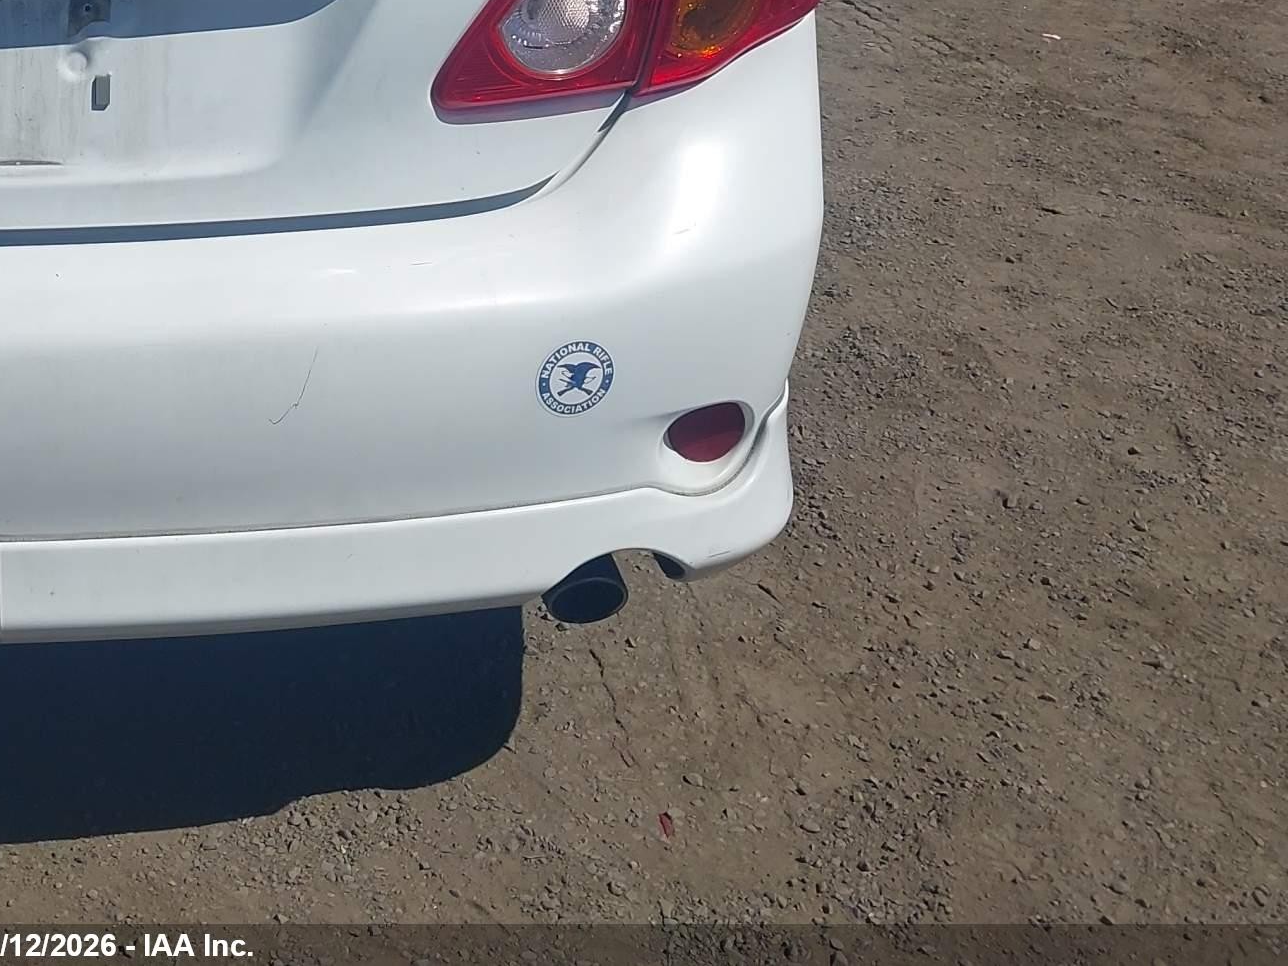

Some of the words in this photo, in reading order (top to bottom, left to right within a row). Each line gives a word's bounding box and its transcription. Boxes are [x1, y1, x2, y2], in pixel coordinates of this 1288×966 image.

[541, 342, 592, 379] NATIONAL
[592, 346, 613, 376] RIFLE
[541, 388, 606, 414] ASSOCIATION
